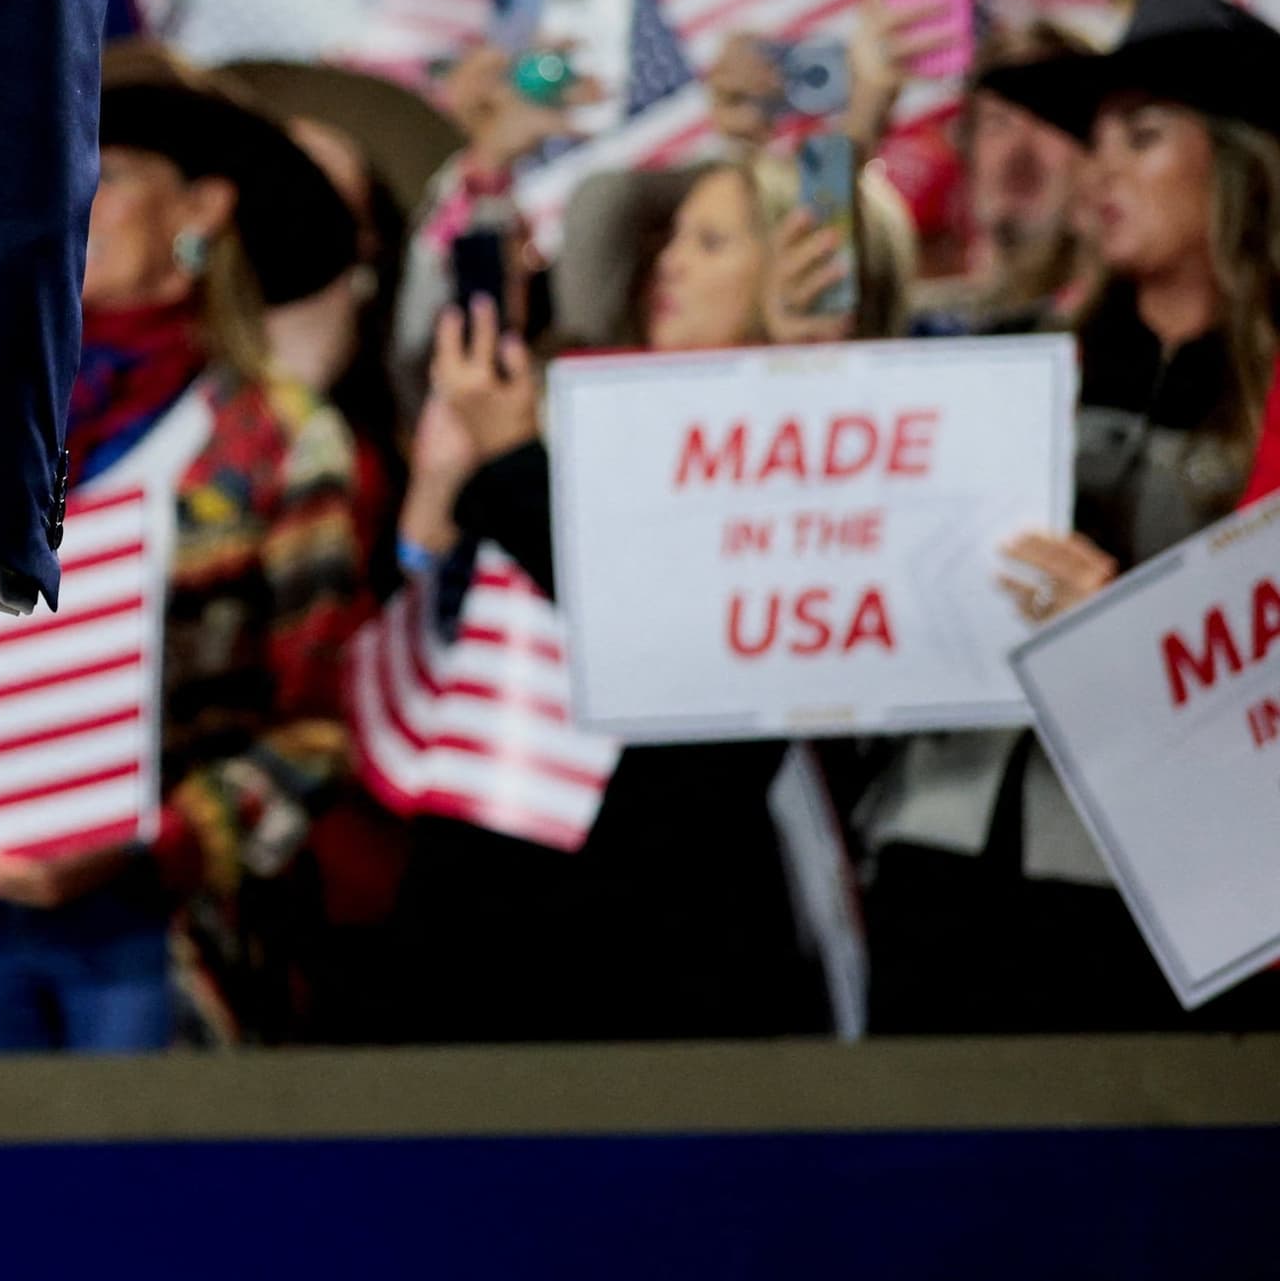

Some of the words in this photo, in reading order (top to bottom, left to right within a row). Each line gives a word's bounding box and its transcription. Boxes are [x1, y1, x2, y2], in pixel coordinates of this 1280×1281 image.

[675, 409, 938, 486] MADE
[724, 520, 772, 555] IN
[793, 509, 881, 551] THE
[724, 584, 897, 660] USA
